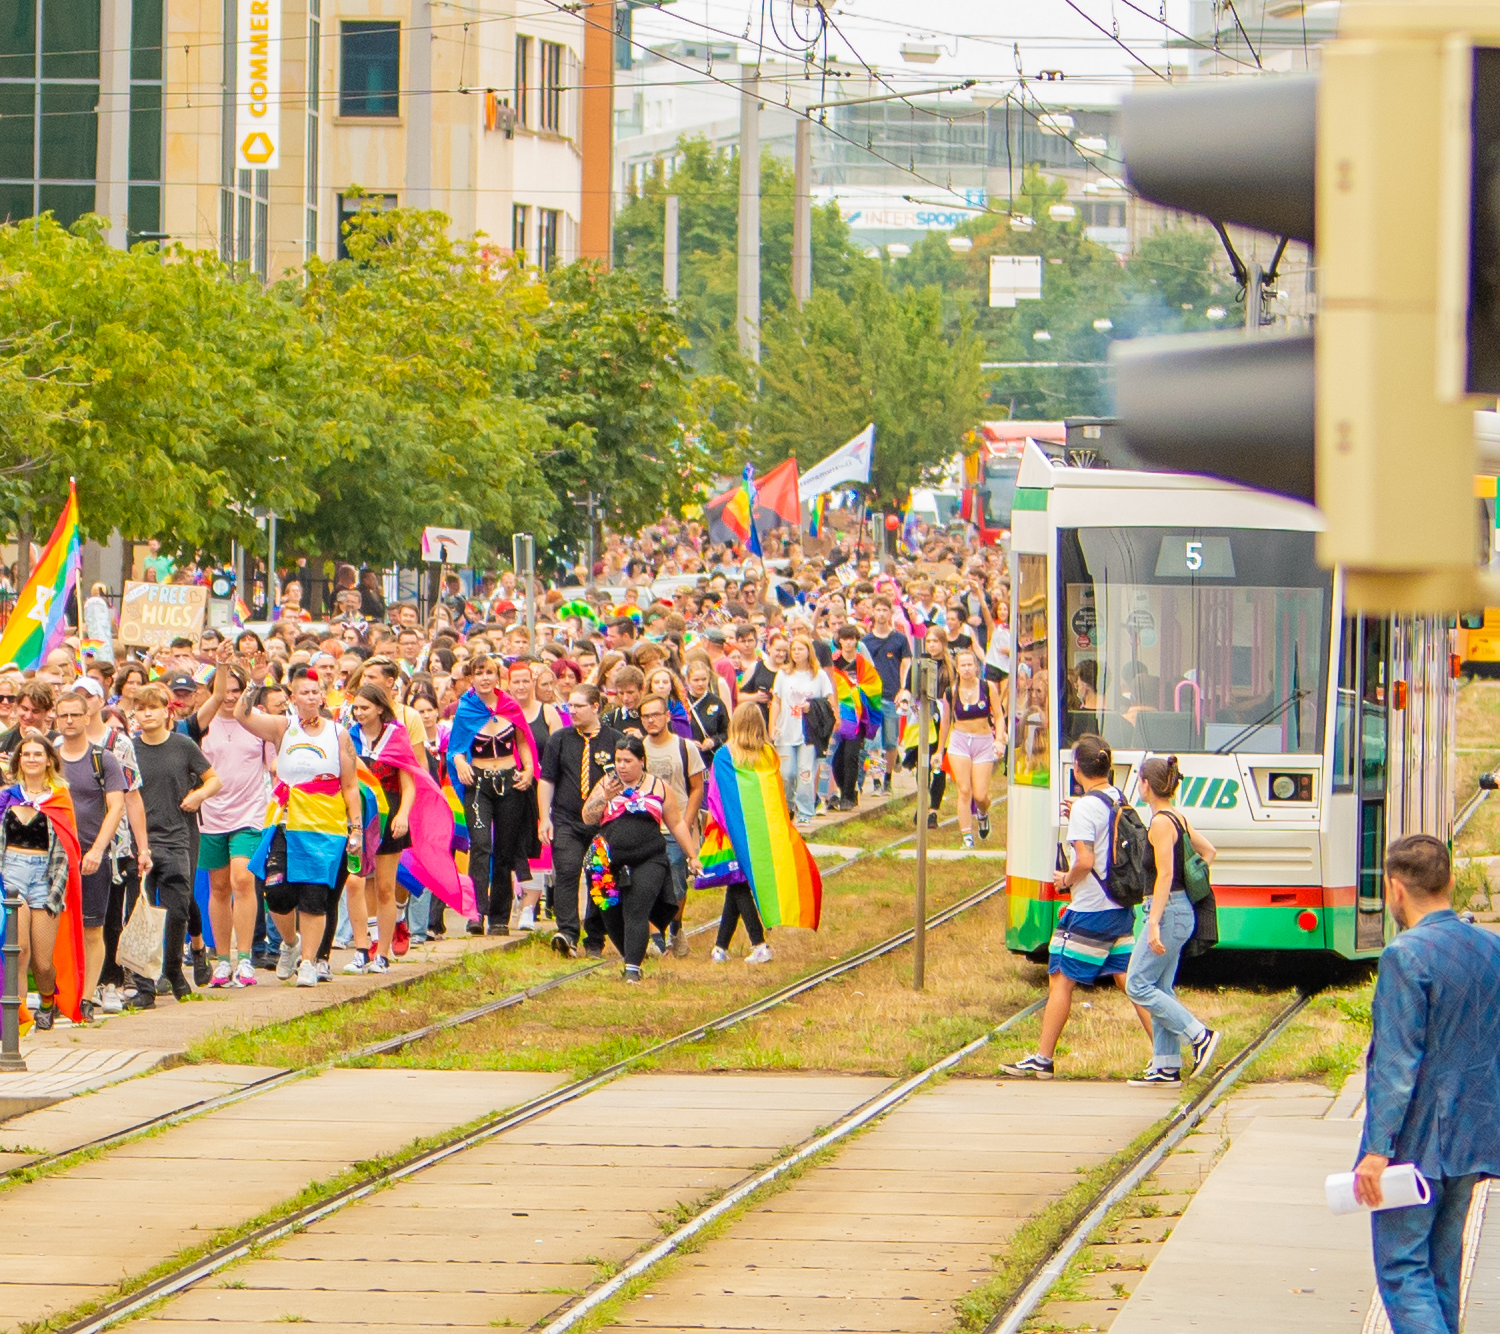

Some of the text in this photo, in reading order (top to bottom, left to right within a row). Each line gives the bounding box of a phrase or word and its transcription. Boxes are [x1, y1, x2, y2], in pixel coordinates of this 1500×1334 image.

[865, 211, 968, 226] INTERSPORT
[1186, 542, 1203, 570] 5
[148, 584, 189, 605] FREE
[141, 603, 193, 627] HUGS
